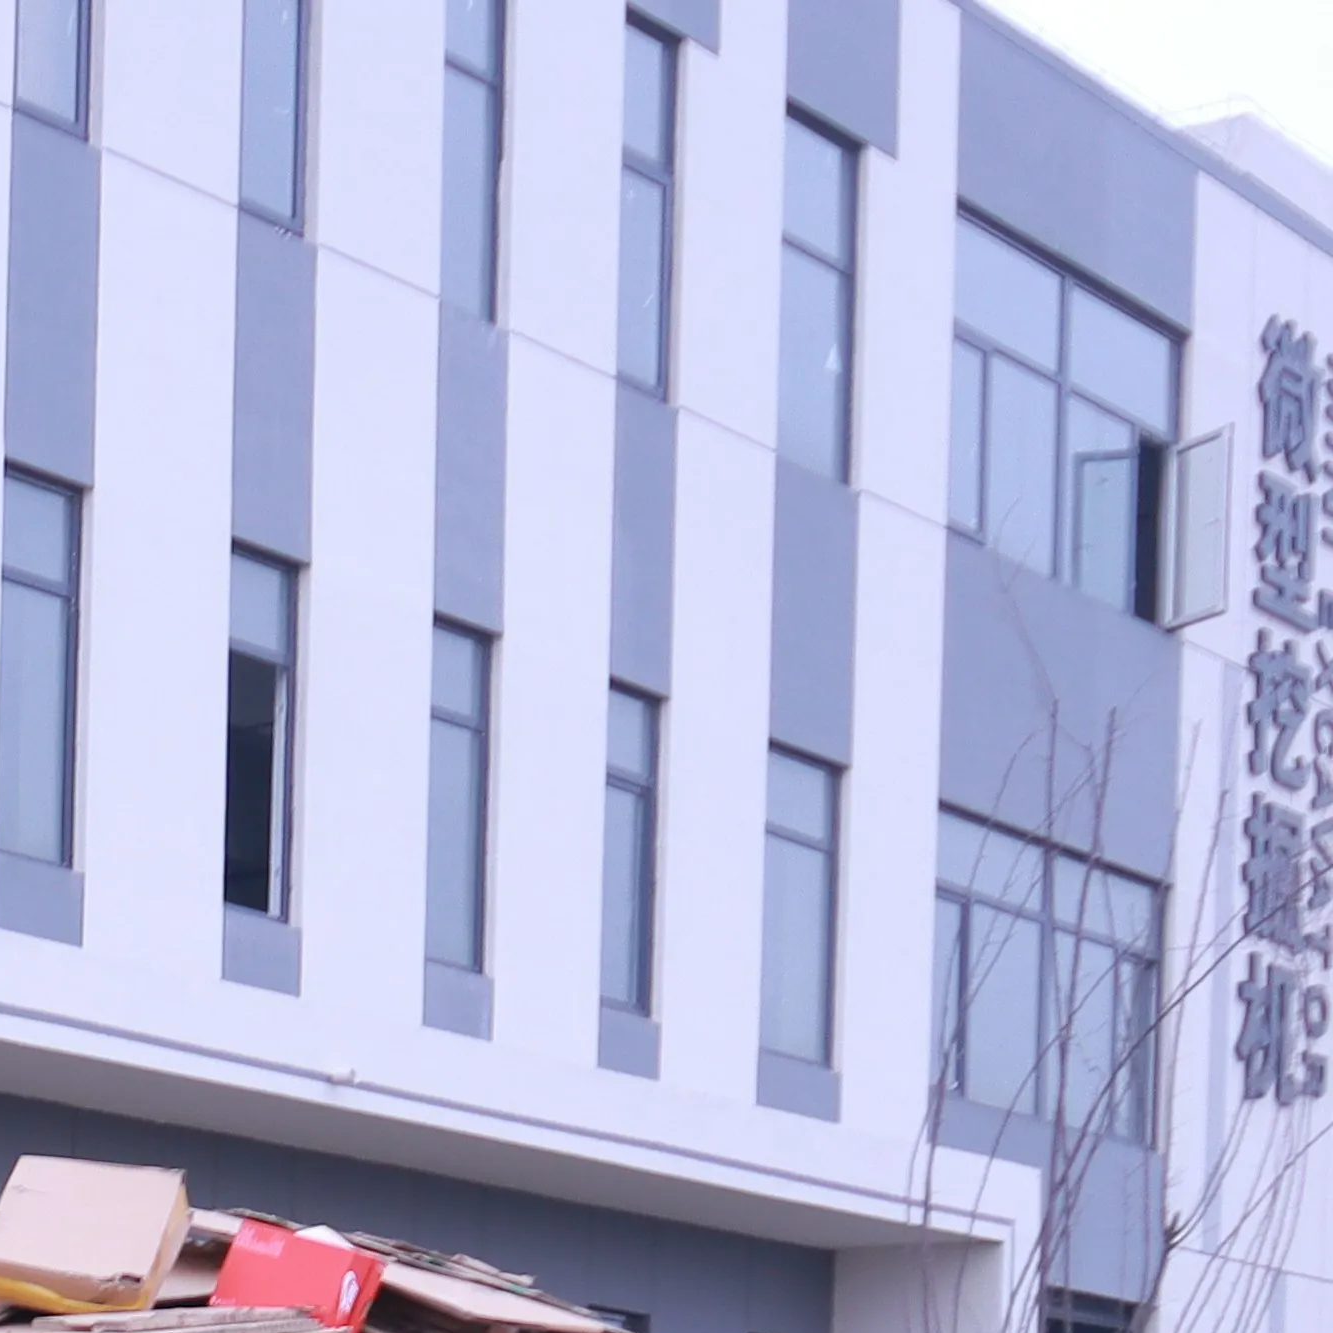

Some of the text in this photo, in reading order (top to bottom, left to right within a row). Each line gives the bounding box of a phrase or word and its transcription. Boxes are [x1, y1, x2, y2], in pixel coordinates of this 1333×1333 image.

[1235, 313, 1318, 1106] 微型挖掘机
